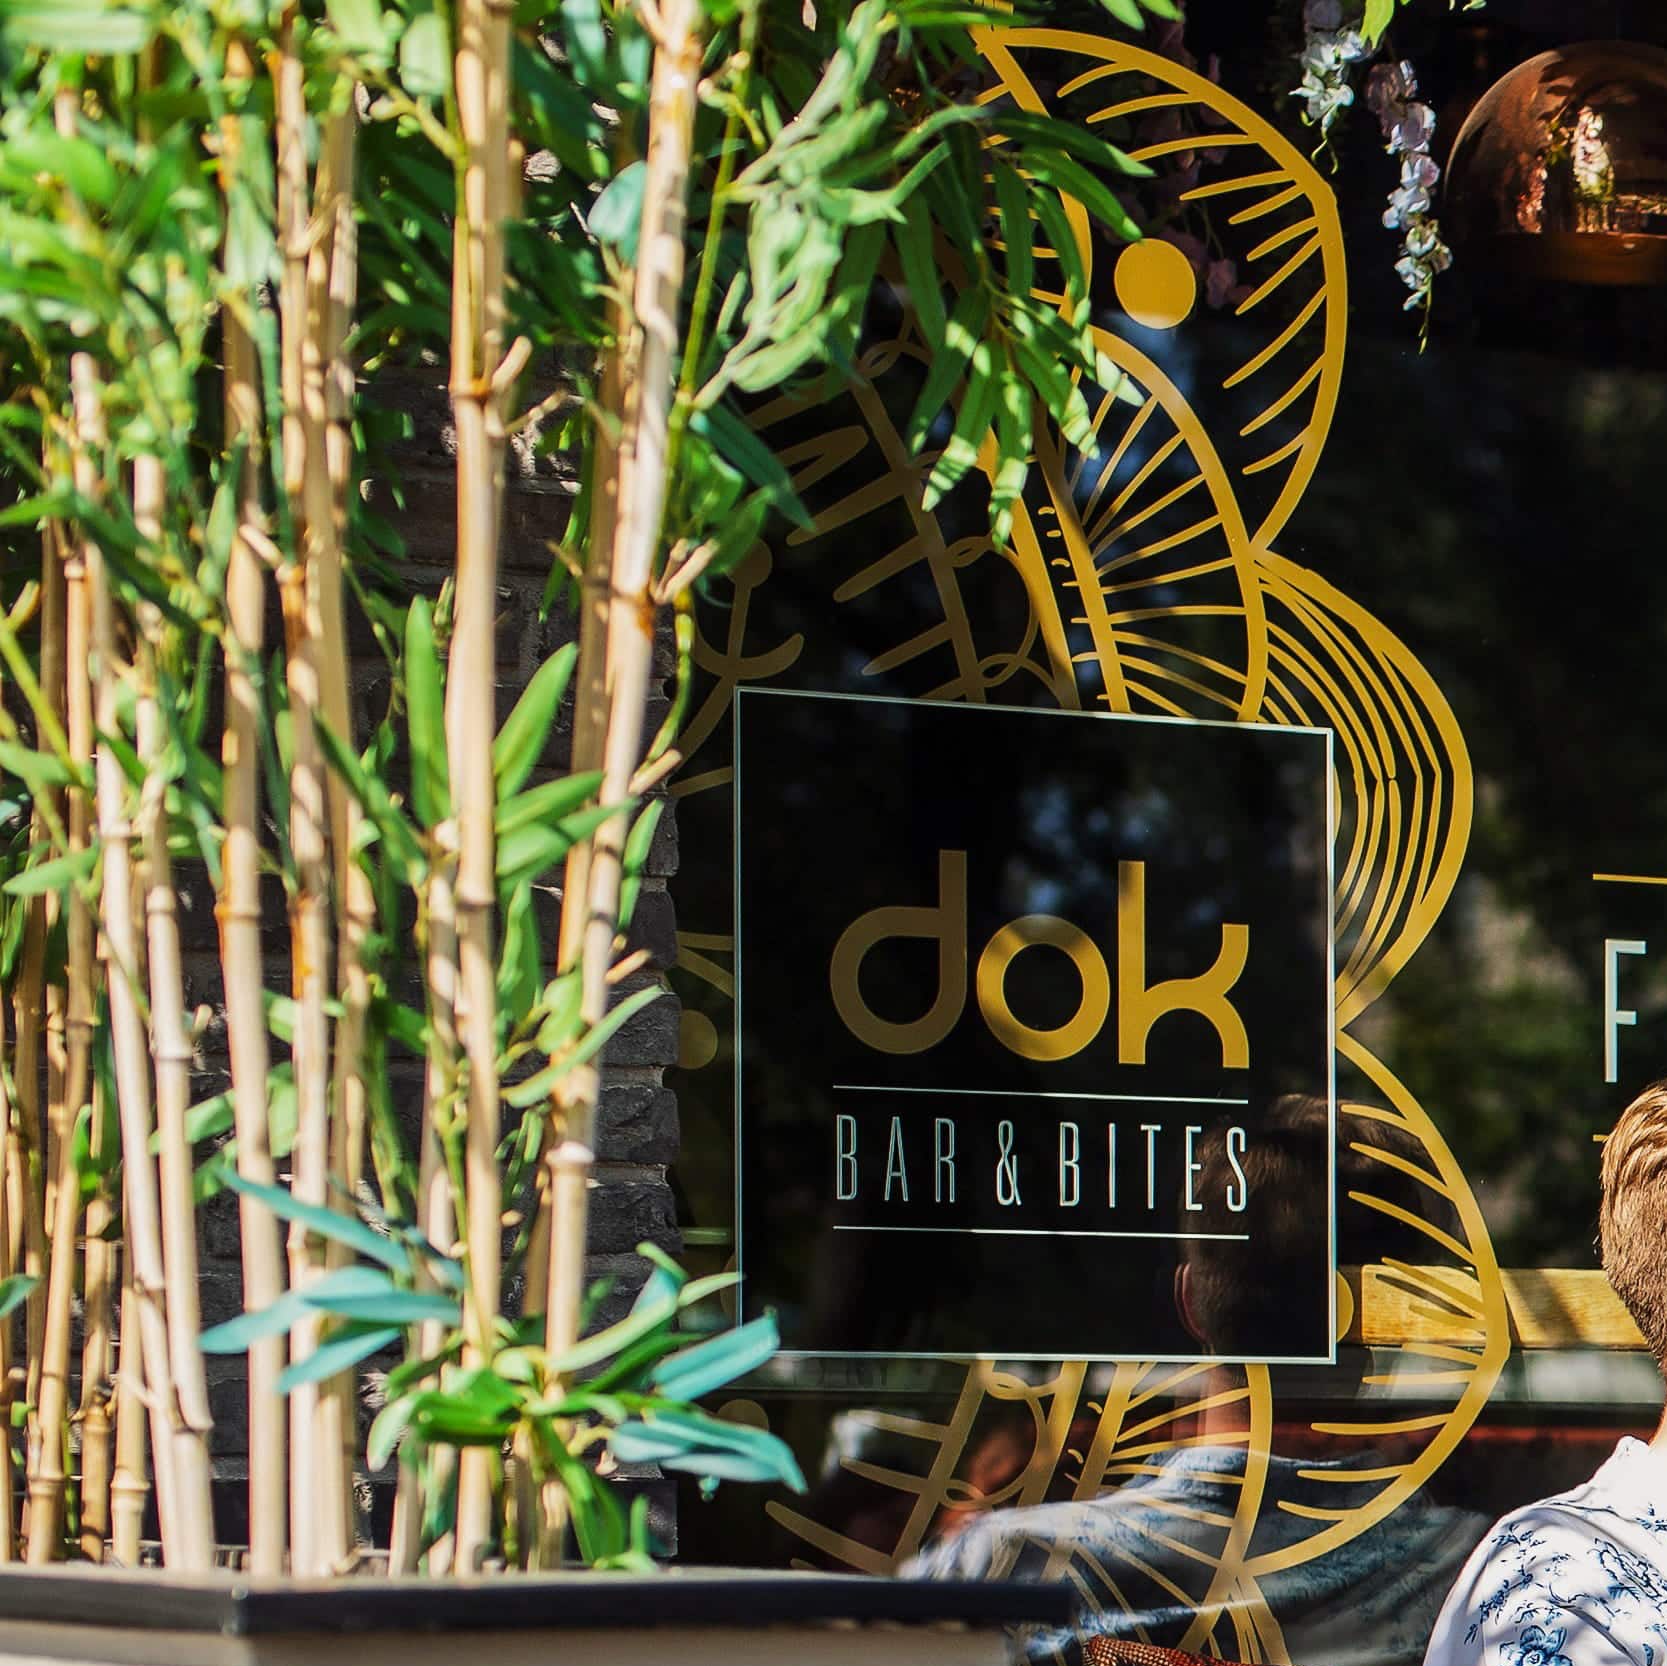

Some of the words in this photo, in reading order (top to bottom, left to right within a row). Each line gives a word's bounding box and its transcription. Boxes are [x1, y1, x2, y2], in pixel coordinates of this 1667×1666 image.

[830, 850, 1250, 1070] dok
[836, 1113, 956, 1204] BAR
[996, 1120, 1022, 1207] &
[1059, 1121, 1248, 1213] BITES
